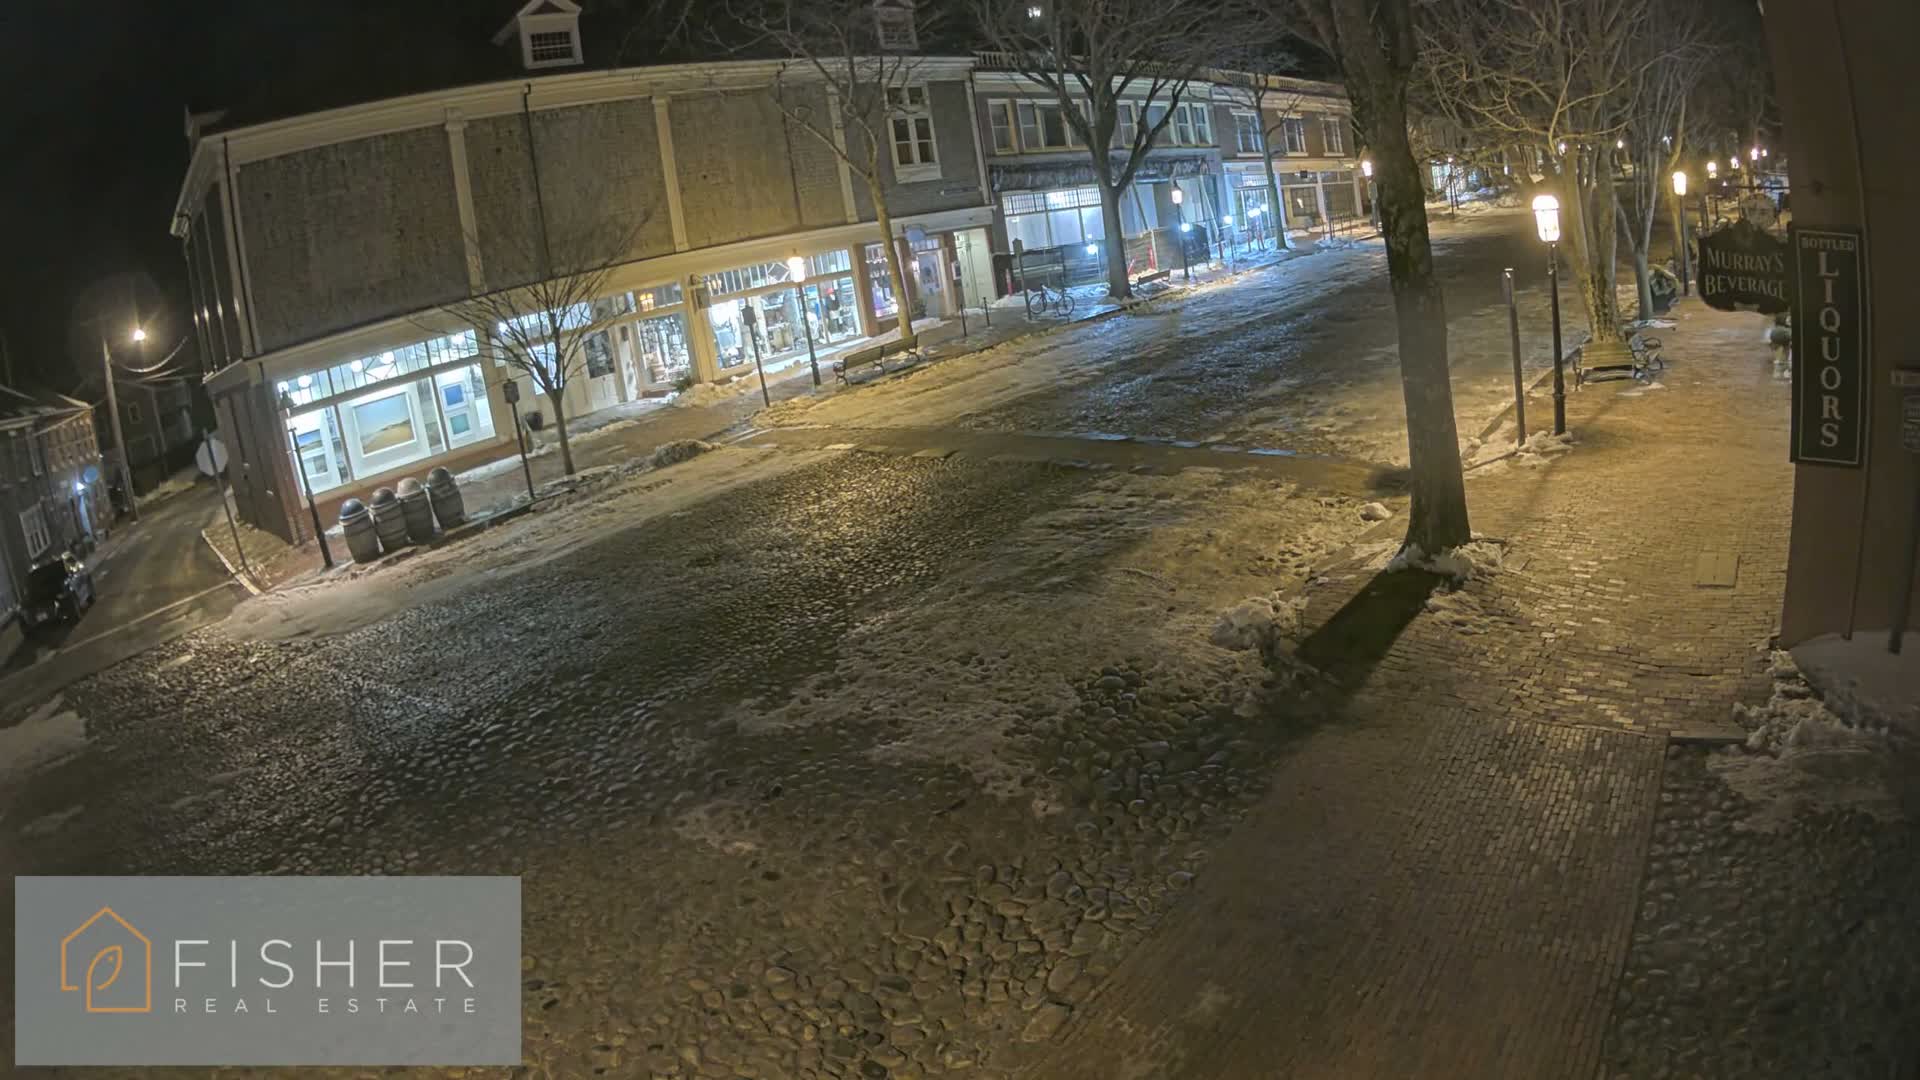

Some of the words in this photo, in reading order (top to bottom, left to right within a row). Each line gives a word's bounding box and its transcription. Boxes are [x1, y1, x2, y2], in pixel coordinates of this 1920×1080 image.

[1801, 236, 1855, 251] BOTTLED
[1706, 248, 1785, 273] MURRAY'S
[1818, 251, 1843, 448] LIQUORS
